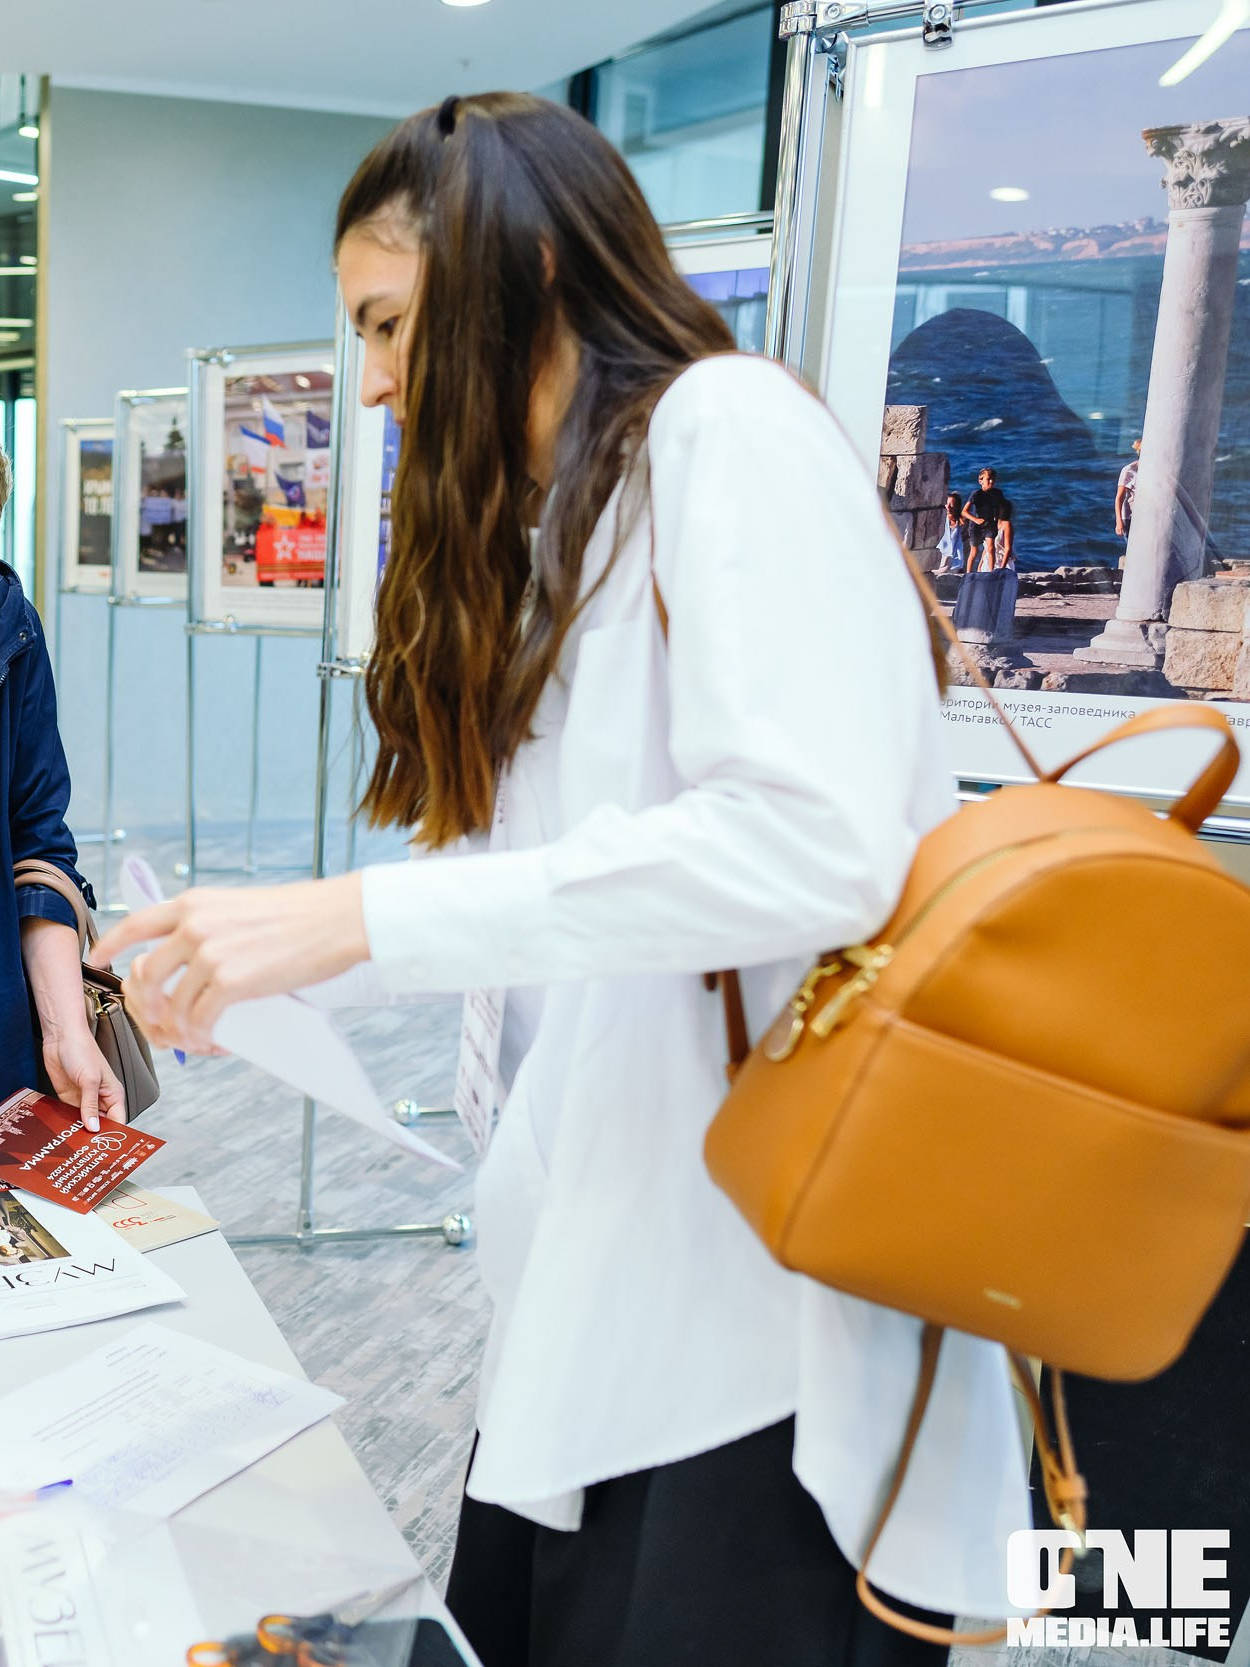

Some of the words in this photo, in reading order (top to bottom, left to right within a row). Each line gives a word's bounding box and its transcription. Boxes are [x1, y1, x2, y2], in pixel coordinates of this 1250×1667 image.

[1003, 703, 1136, 719] музея-заповедника
[1020, 716, 1053, 729] ТАСС
[19, 1120, 85, 1171] ПРОГРАММА
[63, 1145, 90, 1168] ФОРУМ
[47, 1165, 66, 1181] 2024
[52, 1148, 100, 1188] КУЛЬТУРНЫЙ
[59, 1152, 109, 1194] БАЛТИЙСКИЙ
